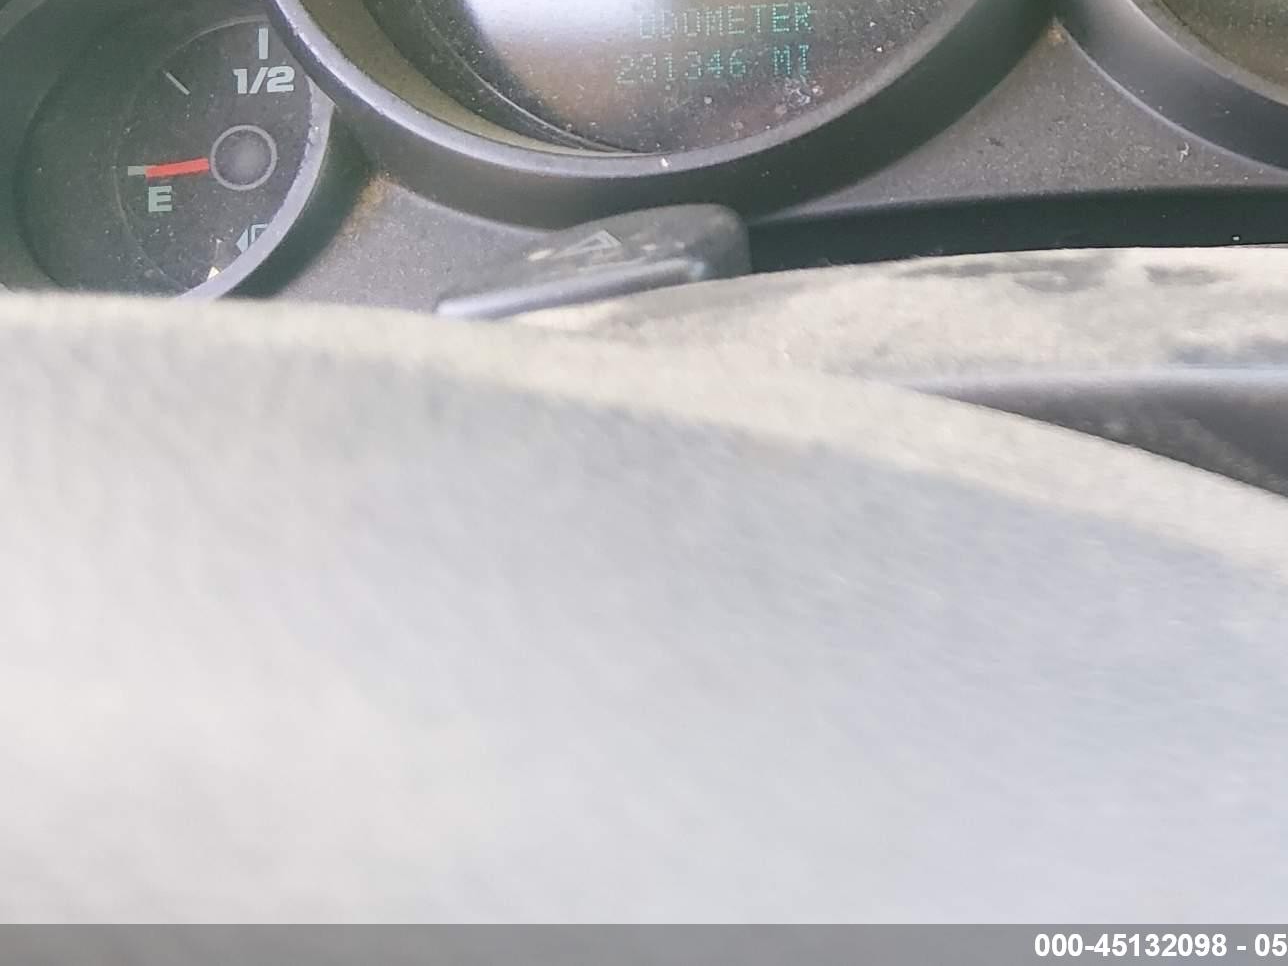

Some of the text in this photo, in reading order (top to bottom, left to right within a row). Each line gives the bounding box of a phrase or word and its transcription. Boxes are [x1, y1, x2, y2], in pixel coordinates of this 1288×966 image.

[772, 44, 811, 77] MI
[233, 65, 295, 94] 1/2
[148, 185, 173, 212] E
